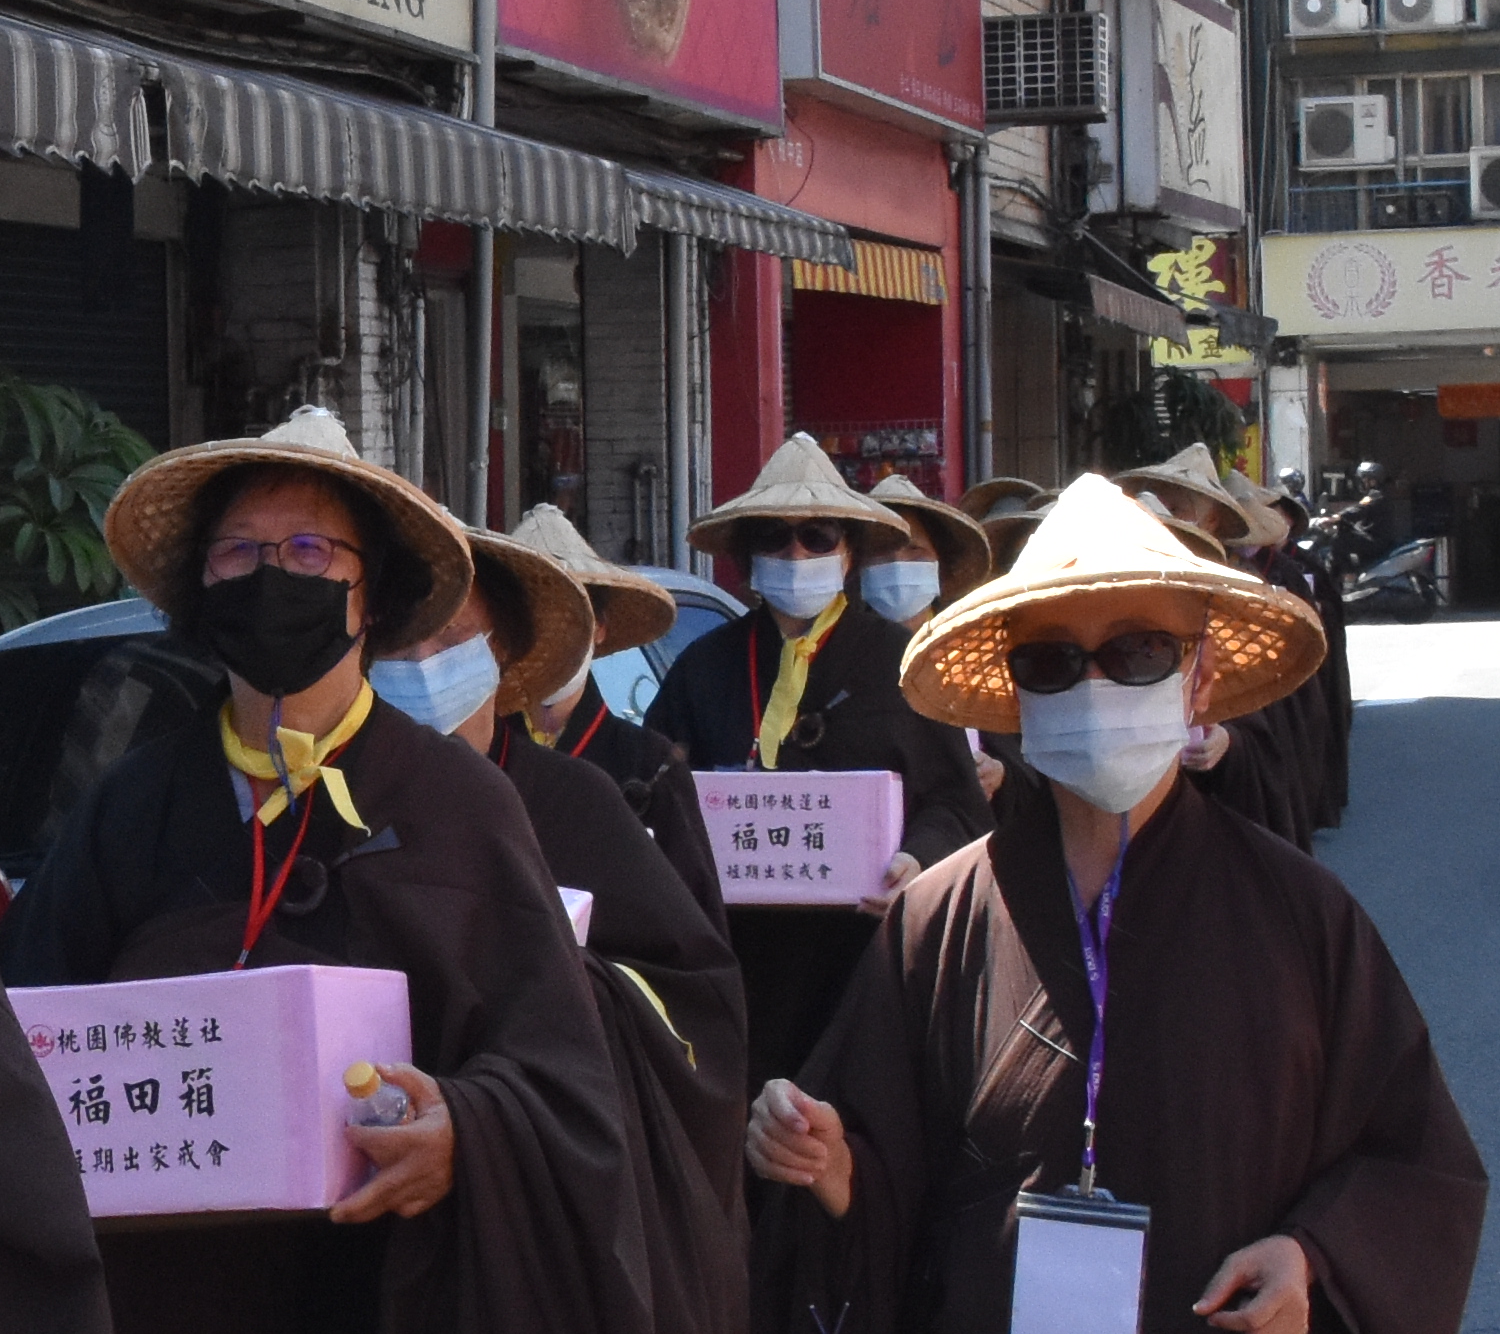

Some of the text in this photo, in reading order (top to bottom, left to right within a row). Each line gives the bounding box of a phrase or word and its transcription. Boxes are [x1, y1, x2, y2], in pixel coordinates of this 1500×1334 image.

[731, 822, 825, 852] 福田箱
[57, 1017, 224, 1055] 桃園佛教蓮社
[67, 1067, 216, 1127] 福田箱
